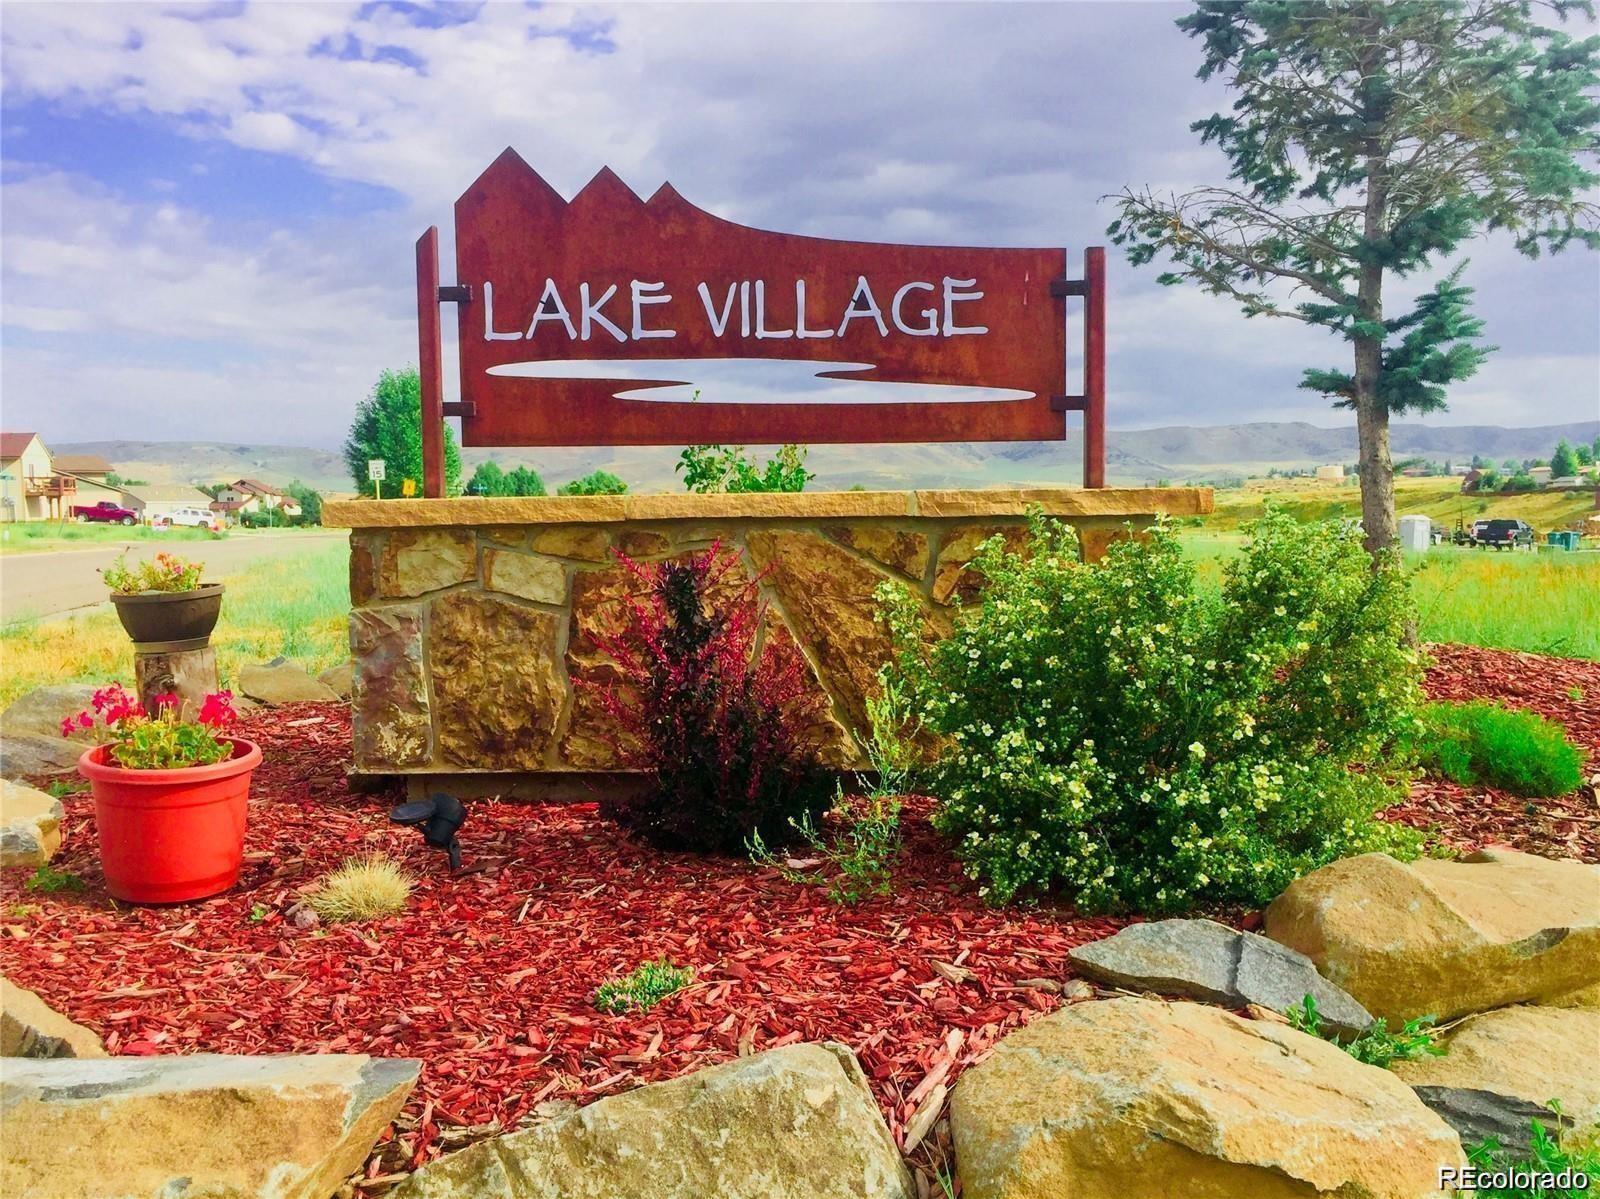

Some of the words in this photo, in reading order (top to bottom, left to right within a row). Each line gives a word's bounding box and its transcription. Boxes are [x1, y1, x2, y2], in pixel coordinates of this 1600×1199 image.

[484, 278, 676, 343] LAKE
[697, 276, 989, 341] VILLAGE
[372, 470, 382, 478] 15
